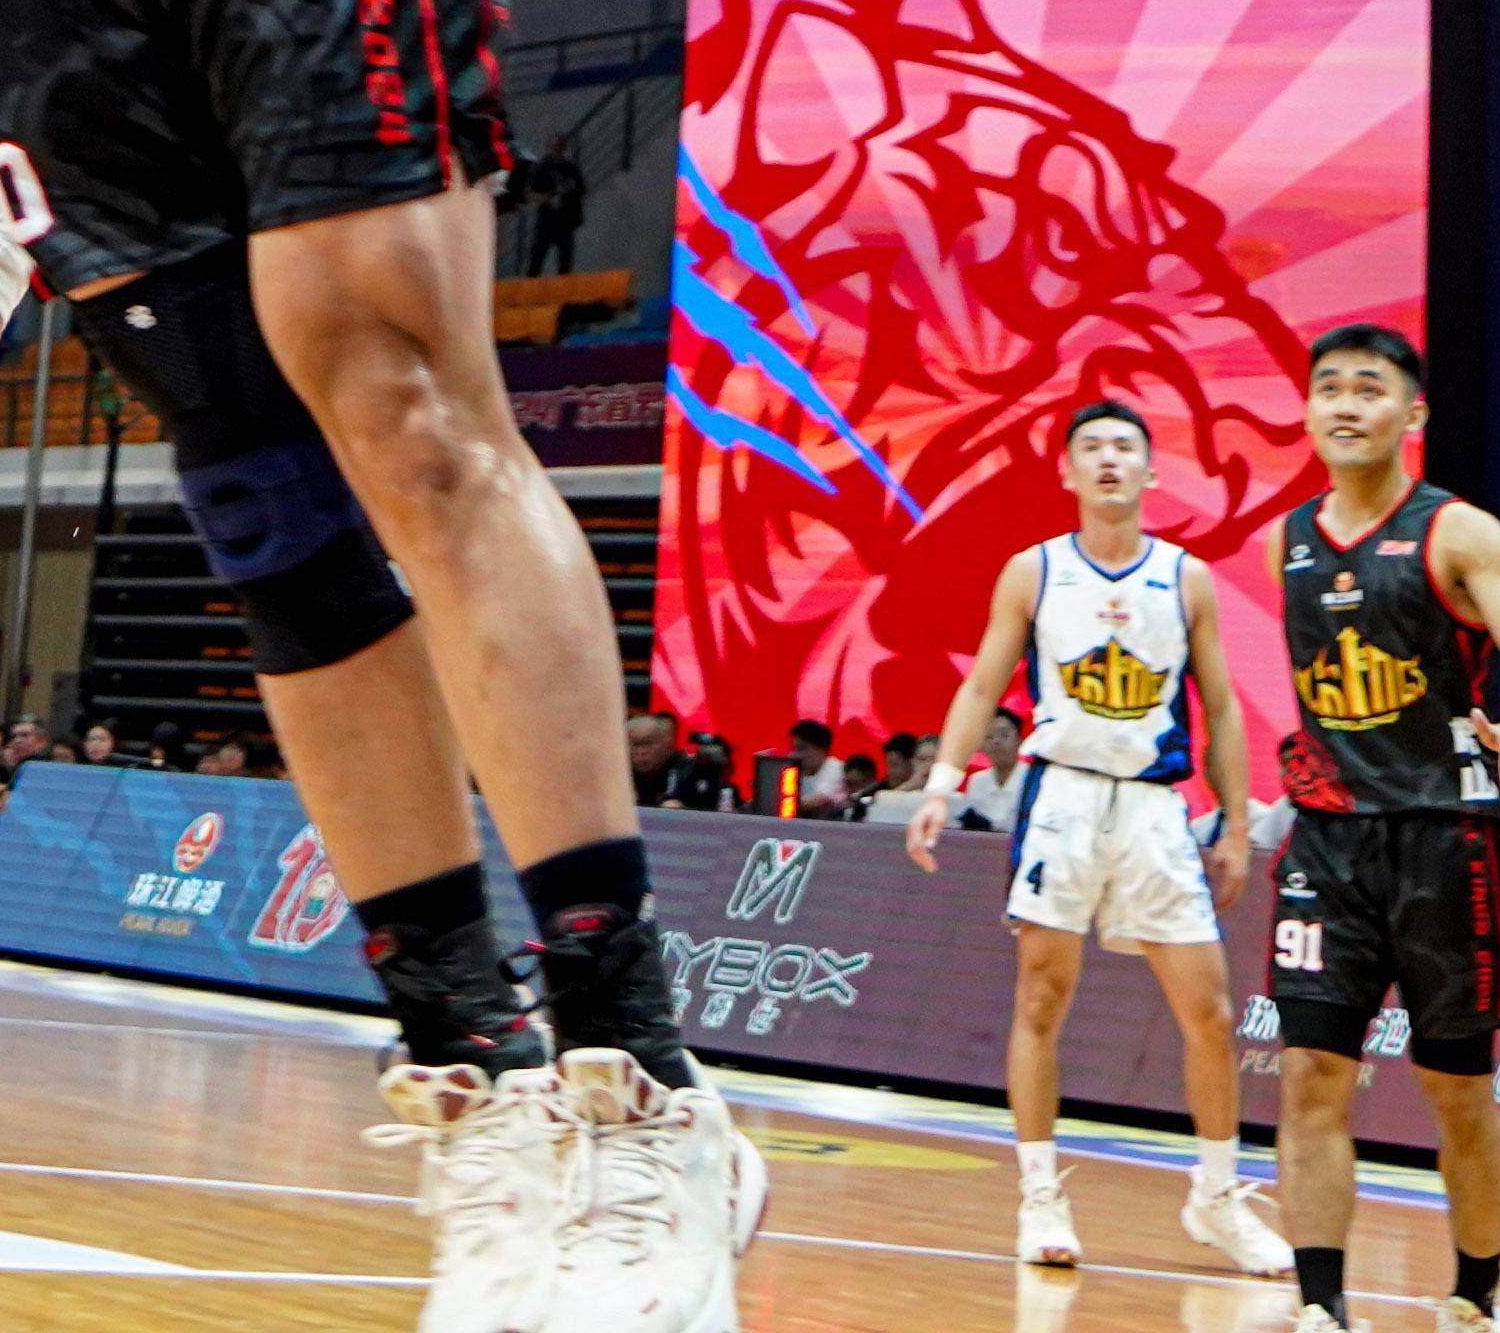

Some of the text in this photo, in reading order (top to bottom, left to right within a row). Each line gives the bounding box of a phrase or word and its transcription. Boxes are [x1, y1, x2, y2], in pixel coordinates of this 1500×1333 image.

[1025, 860, 1045, 895] 4
[660, 931, 874, 1007] YBOX
[1274, 919, 1324, 973] 91
